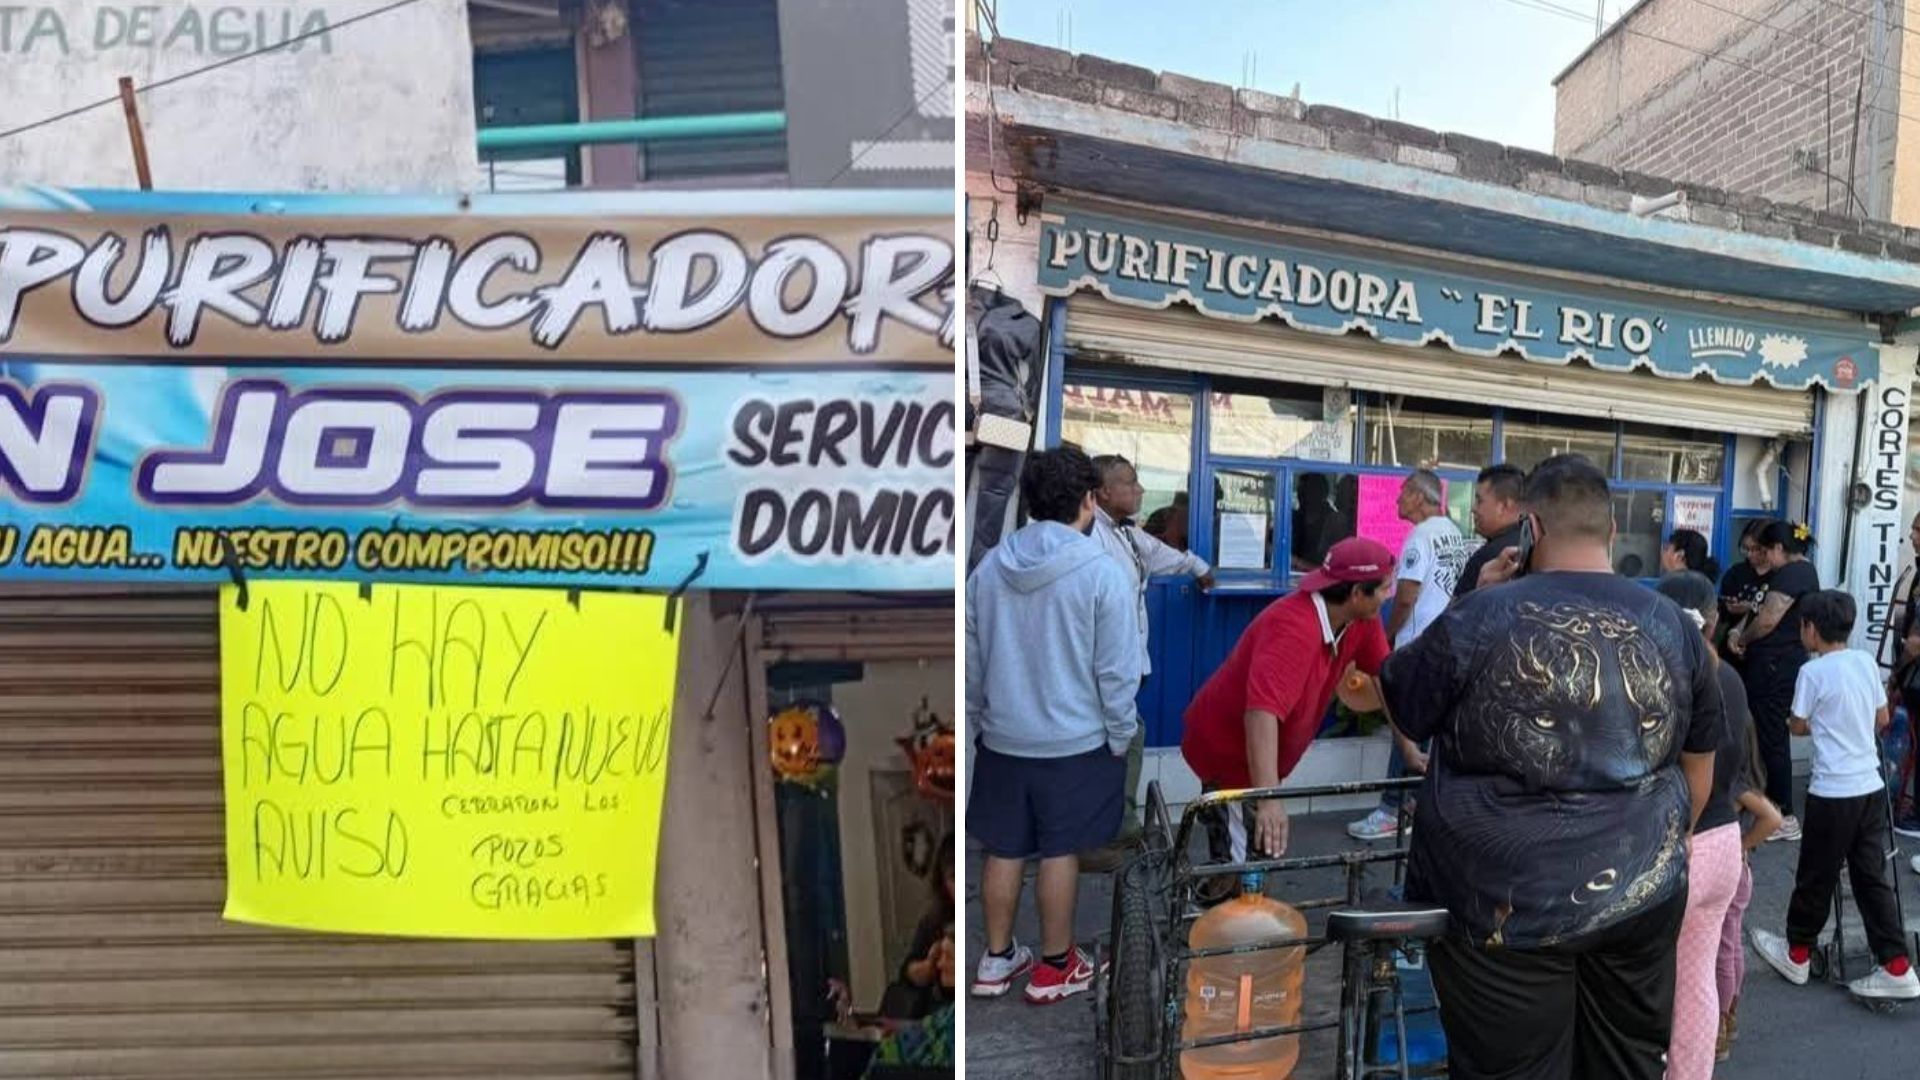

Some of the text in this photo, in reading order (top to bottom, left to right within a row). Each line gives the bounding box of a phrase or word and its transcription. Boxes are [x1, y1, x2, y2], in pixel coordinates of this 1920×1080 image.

[0, 223, 955, 352] PURIFICADOR
[1049, 228, 1422, 324] PURIFICADORA
[1688, 327, 1755, 351] LLENADO
[144, 384, 674, 505] JOSE
[728, 399, 955, 468] SERVIC
[1874, 386, 1906, 511] CORTES
[25, 527, 162, 567] AGUA...
[356, 530, 653, 573] COMPROMISO!!!
[1865, 523, 1895, 642] TINTES
[256, 588, 548, 709] NO HAY
[241, 701, 391, 788] AGUA
[422, 706, 547, 782] HASTA
[254, 799, 408, 882] AVISO
[584, 791, 619, 811] LOS
[471, 834, 563, 868] POZOS
[471, 872, 607, 909] GRACIAS
